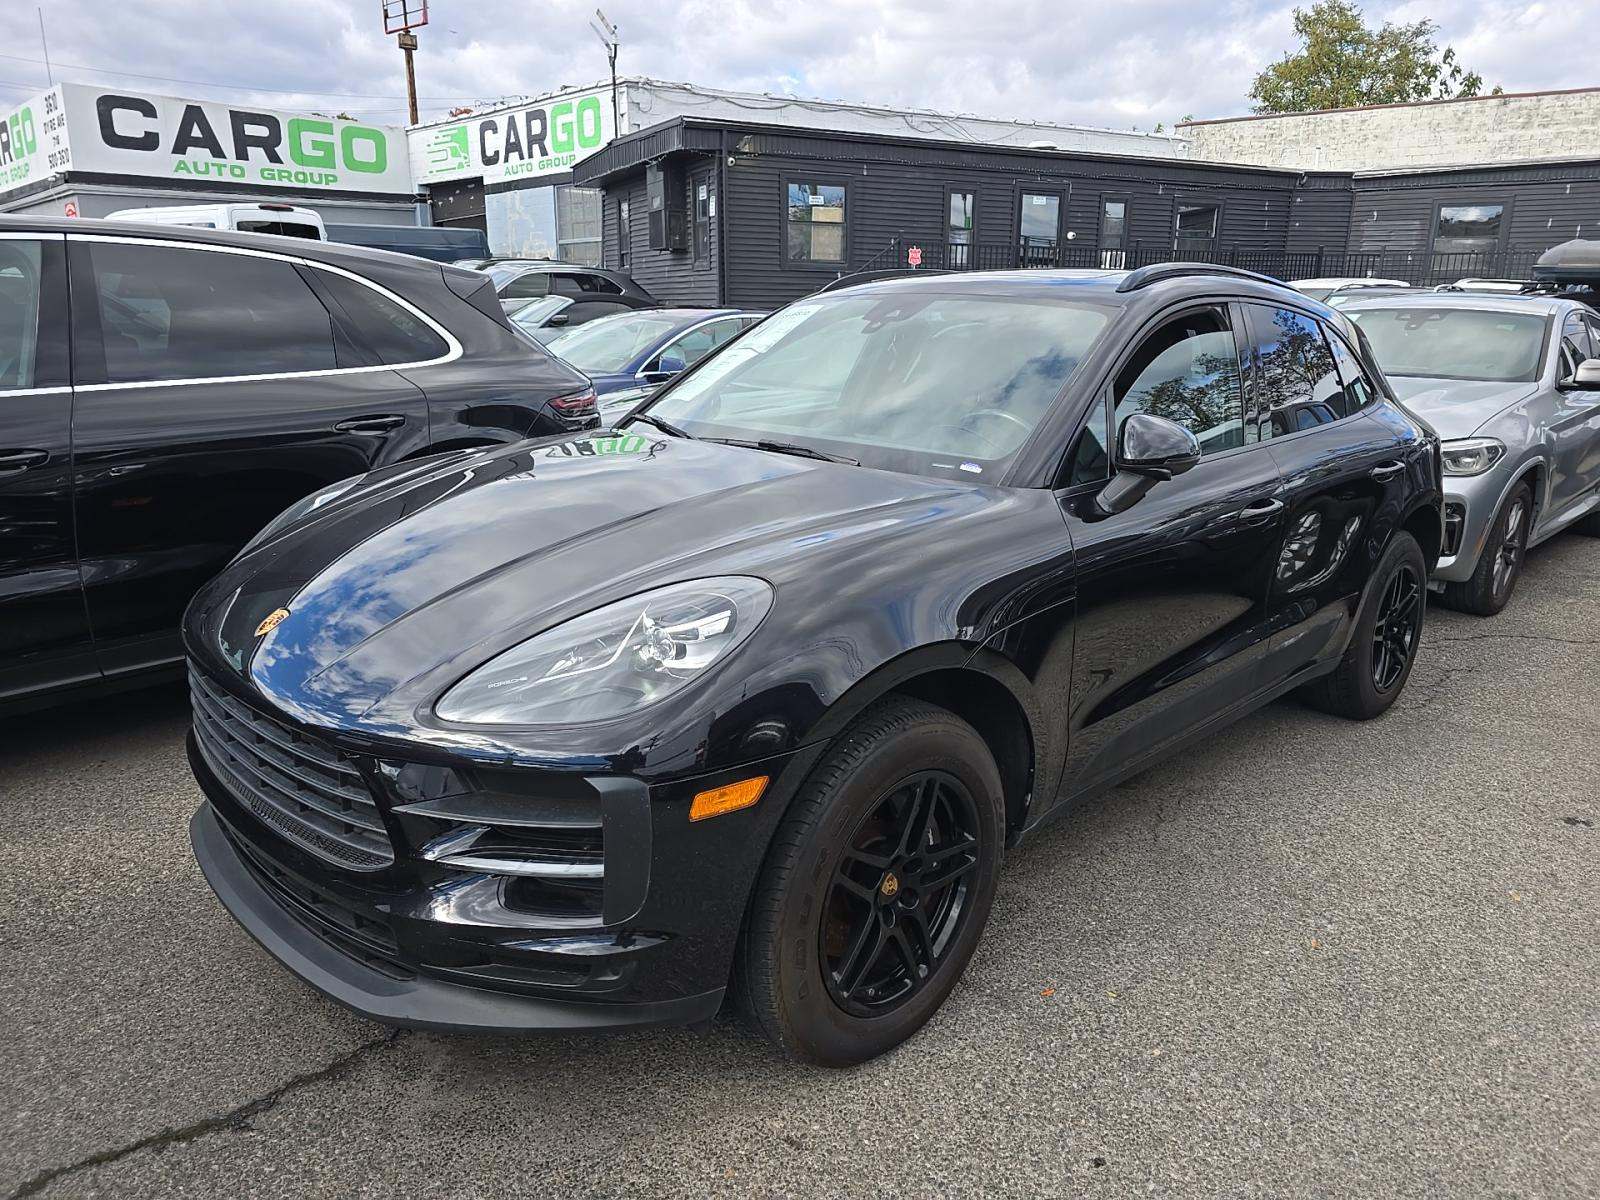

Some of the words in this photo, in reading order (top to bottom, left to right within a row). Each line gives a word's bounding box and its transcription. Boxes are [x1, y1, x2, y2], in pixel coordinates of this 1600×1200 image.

[0, 106, 37, 167] RGO
[96, 94, 387, 174] CARGO
[479, 96, 601, 167] CARGO
[172, 159, 246, 179] AUTO
[259, 167, 338, 186] GROUP
[504, 162, 533, 177] AUTO
[538, 154, 576, 171] GROUP
